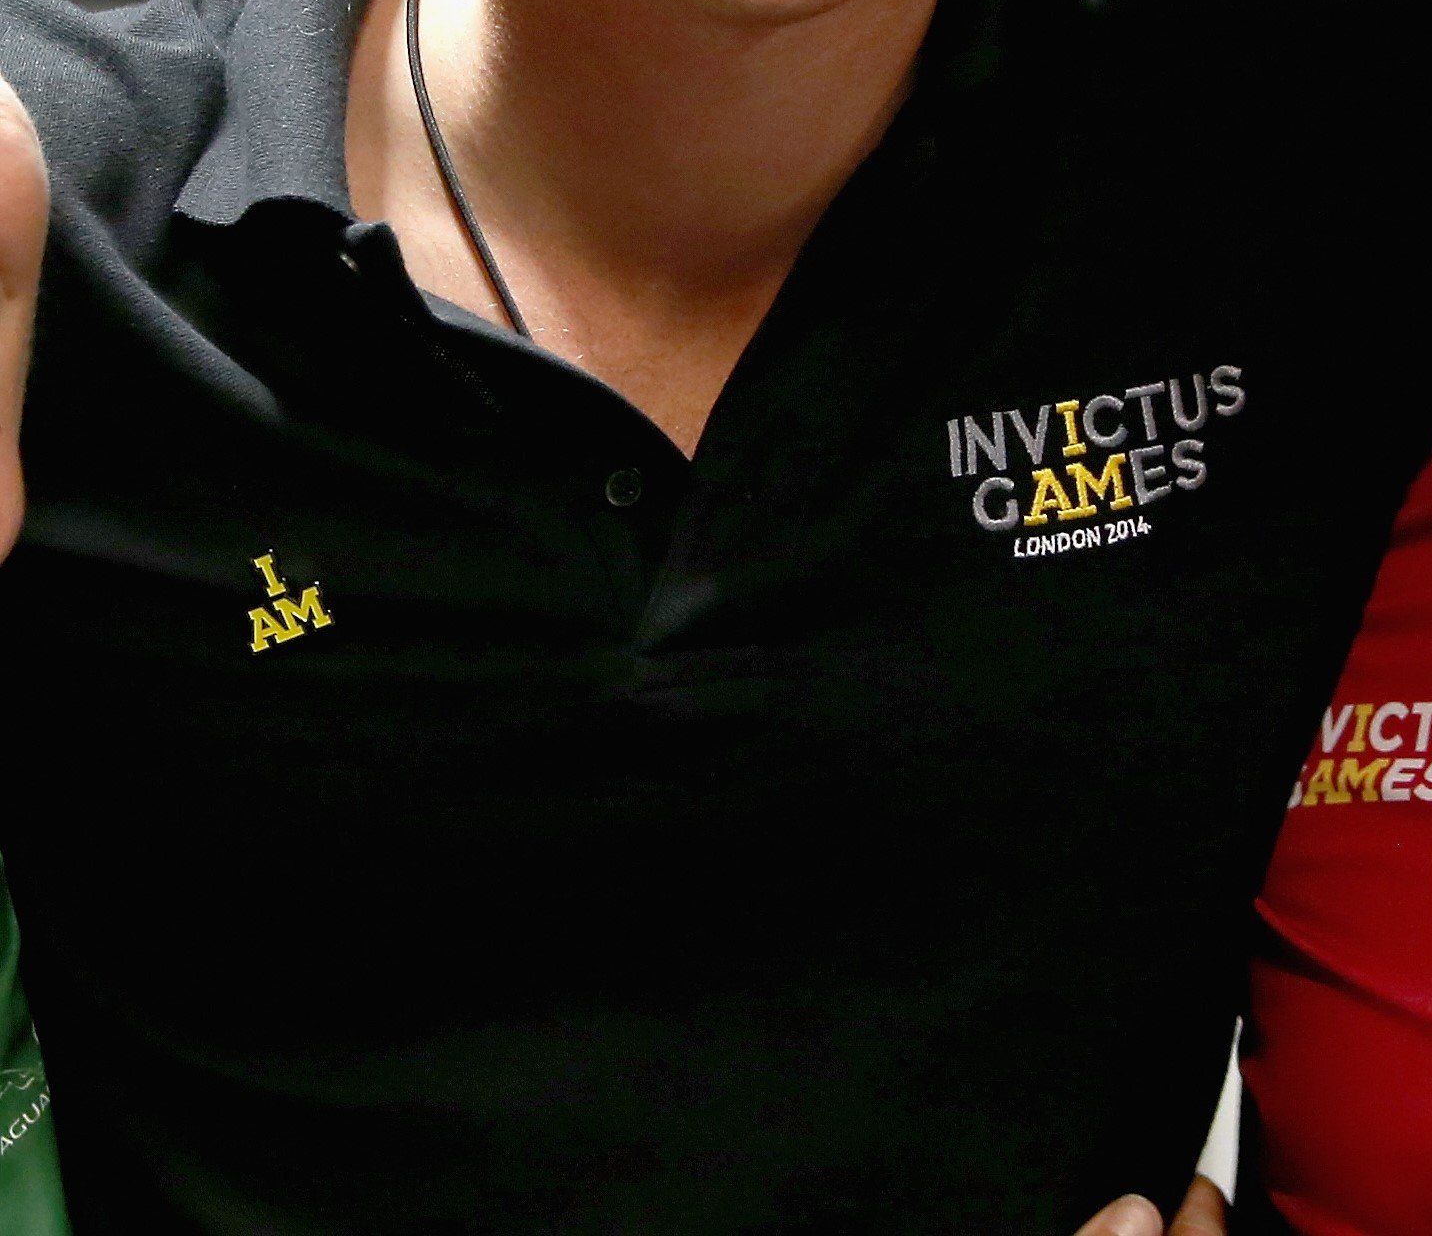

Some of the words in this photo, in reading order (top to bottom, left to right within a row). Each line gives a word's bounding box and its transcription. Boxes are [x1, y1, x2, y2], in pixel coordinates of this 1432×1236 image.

[946, 364, 1247, 478] INVICTUS
[972, 438, 1208, 532] GAMES
[1013, 525, 1101, 558] LONDON
[1103, 515, 1152, 543] 2014
[253, 553, 287, 598] I
[247, 585, 332, 653] AM
[0, 1085, 51, 1156] AGUA
